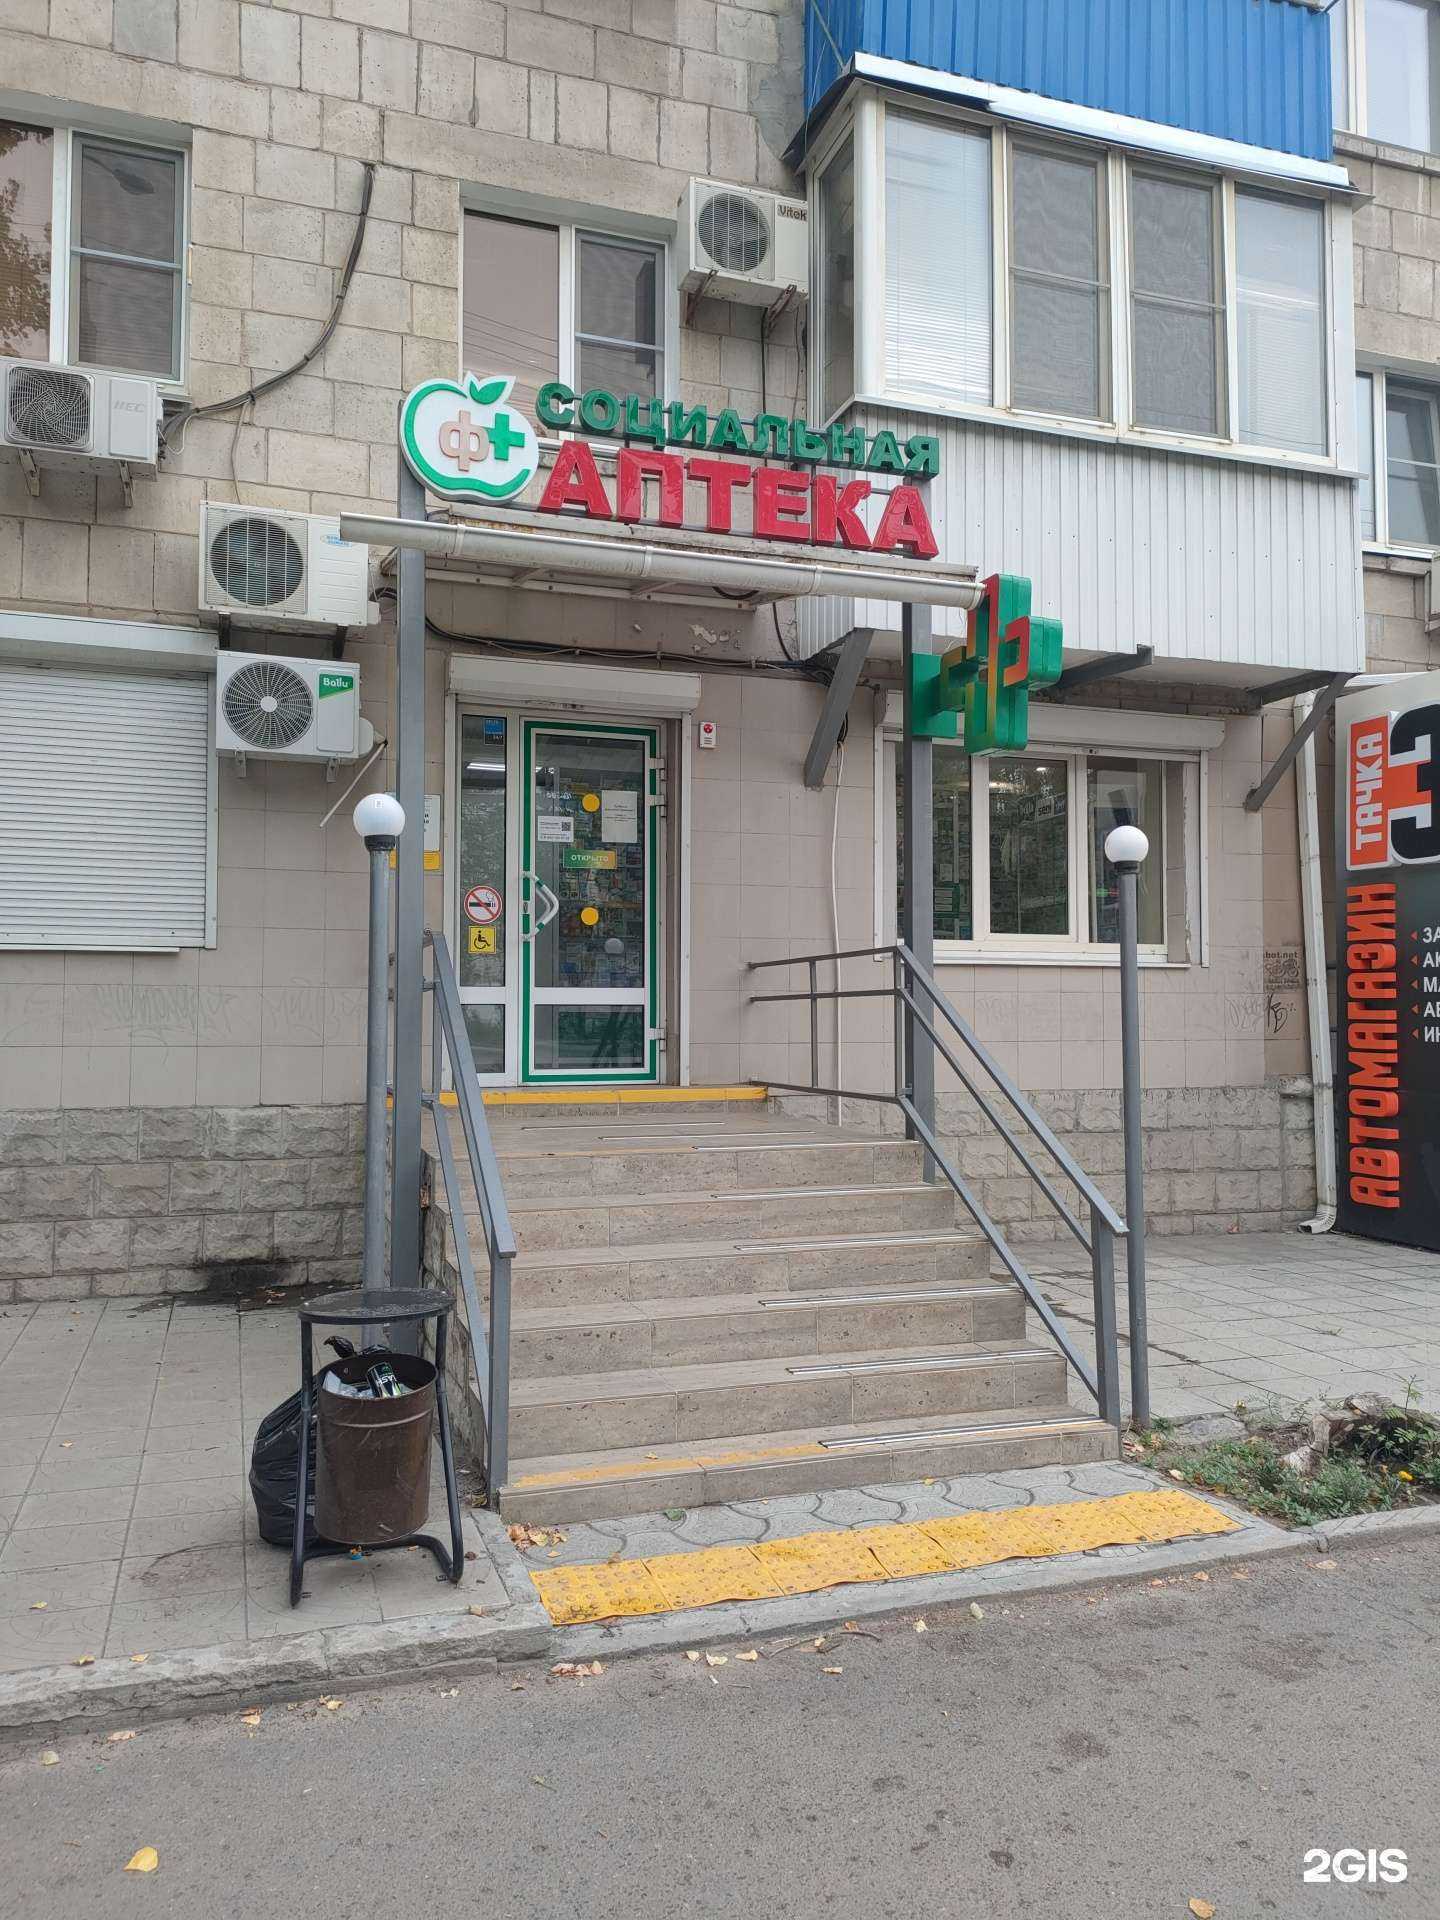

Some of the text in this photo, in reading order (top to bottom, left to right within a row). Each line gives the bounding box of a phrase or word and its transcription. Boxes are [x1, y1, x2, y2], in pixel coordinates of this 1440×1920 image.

[535, 382, 939, 480] СОЦИАЛЬНАЯ
[539, 440, 939, 559] АПТЕКА
[323, 677, 348, 688] Ballu
[1356, 732, 1383, 850] ТАЧКА
[1346, 883, 1400, 1208] АВТОМАГАЗИН
